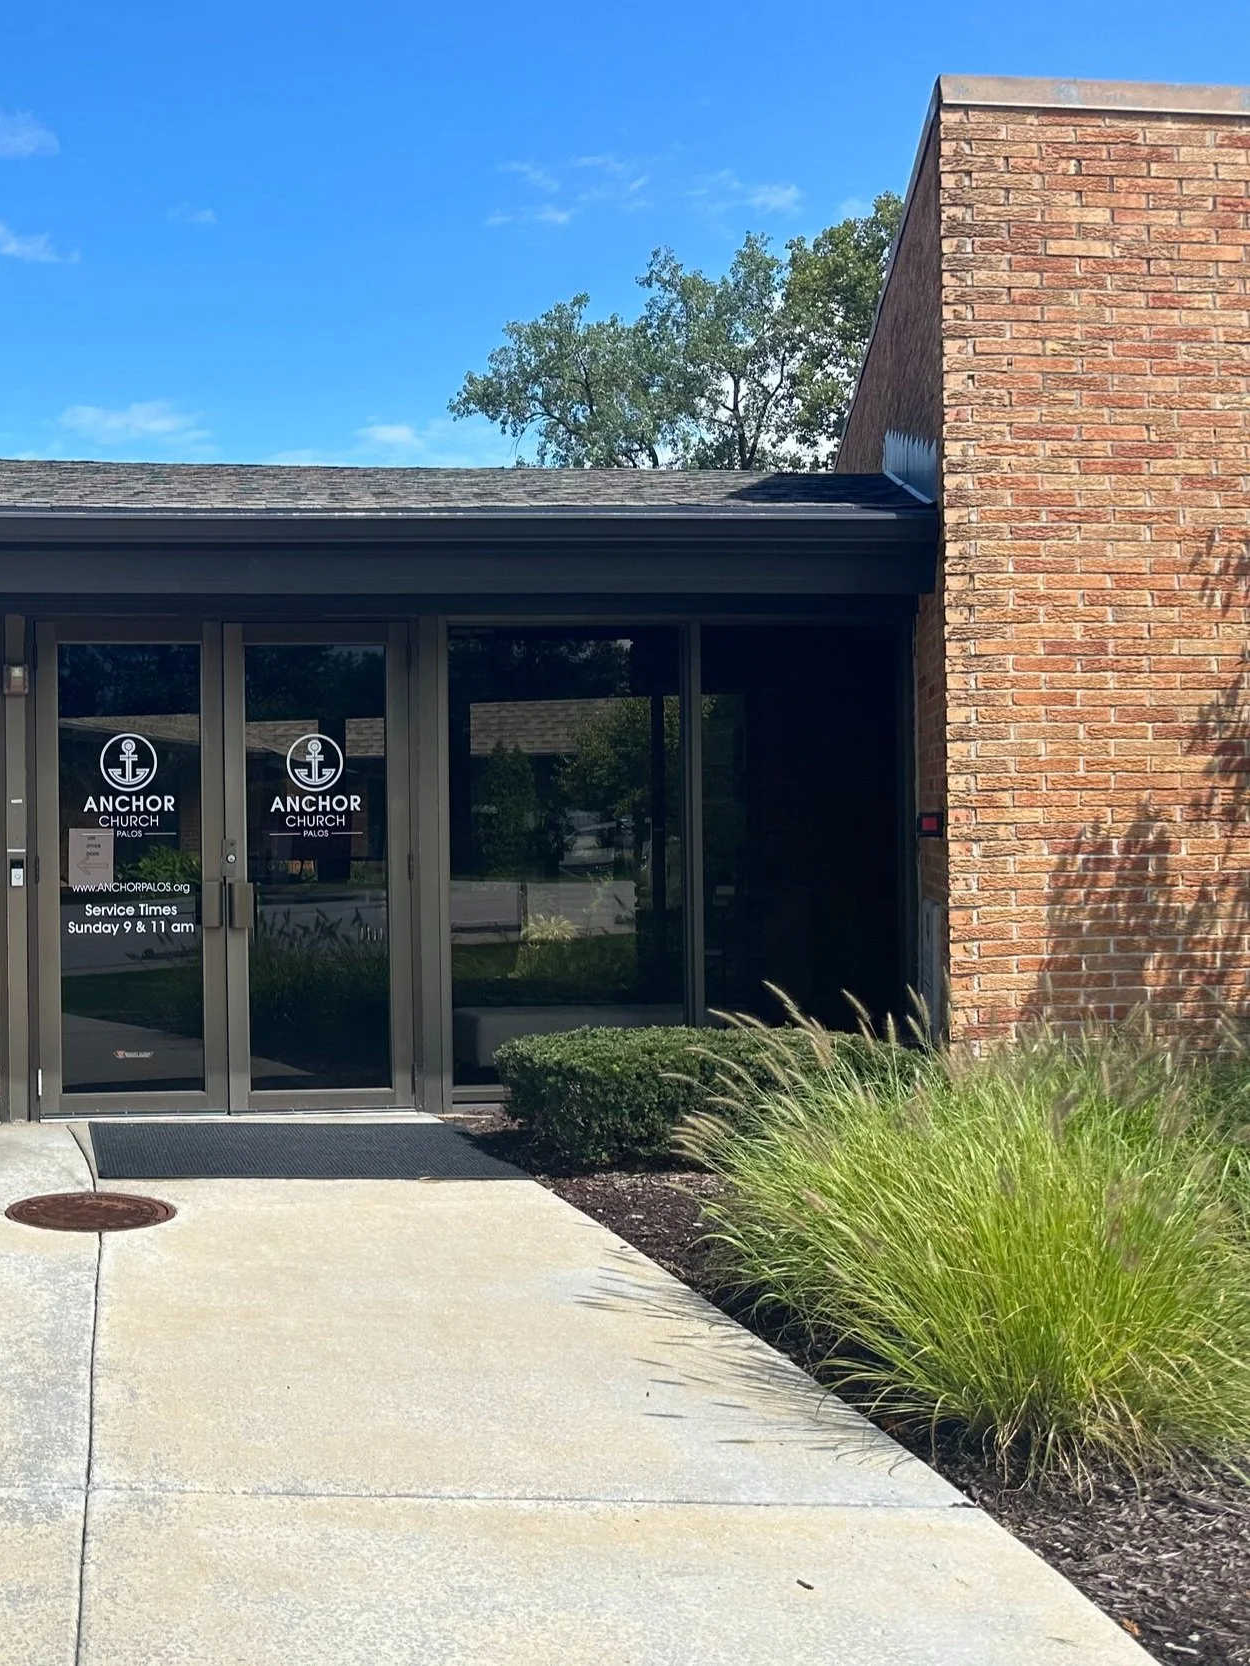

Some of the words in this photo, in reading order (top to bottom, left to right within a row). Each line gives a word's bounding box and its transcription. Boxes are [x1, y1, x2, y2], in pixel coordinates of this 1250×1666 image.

[83, 794, 175, 813] ANCHOR
[270, 794, 361, 813] ANCHOR
[98, 814, 159, 828] CHURCH
[285, 814, 346, 828] CHURCH
[116, 829, 143, 838] PALOS
[303, 829, 329, 838] PALOS
[72, 882, 190, 894] www.ANCHORPALOS.org
[84, 903, 136, 917] Service
[138, 903, 178, 916] Times
[67, 920, 120, 937] Sunday
[123, 920, 132, 934] 9
[135, 920, 147, 934] &
[150, 920, 165, 934] 11
[170, 922, 195, 933] am
